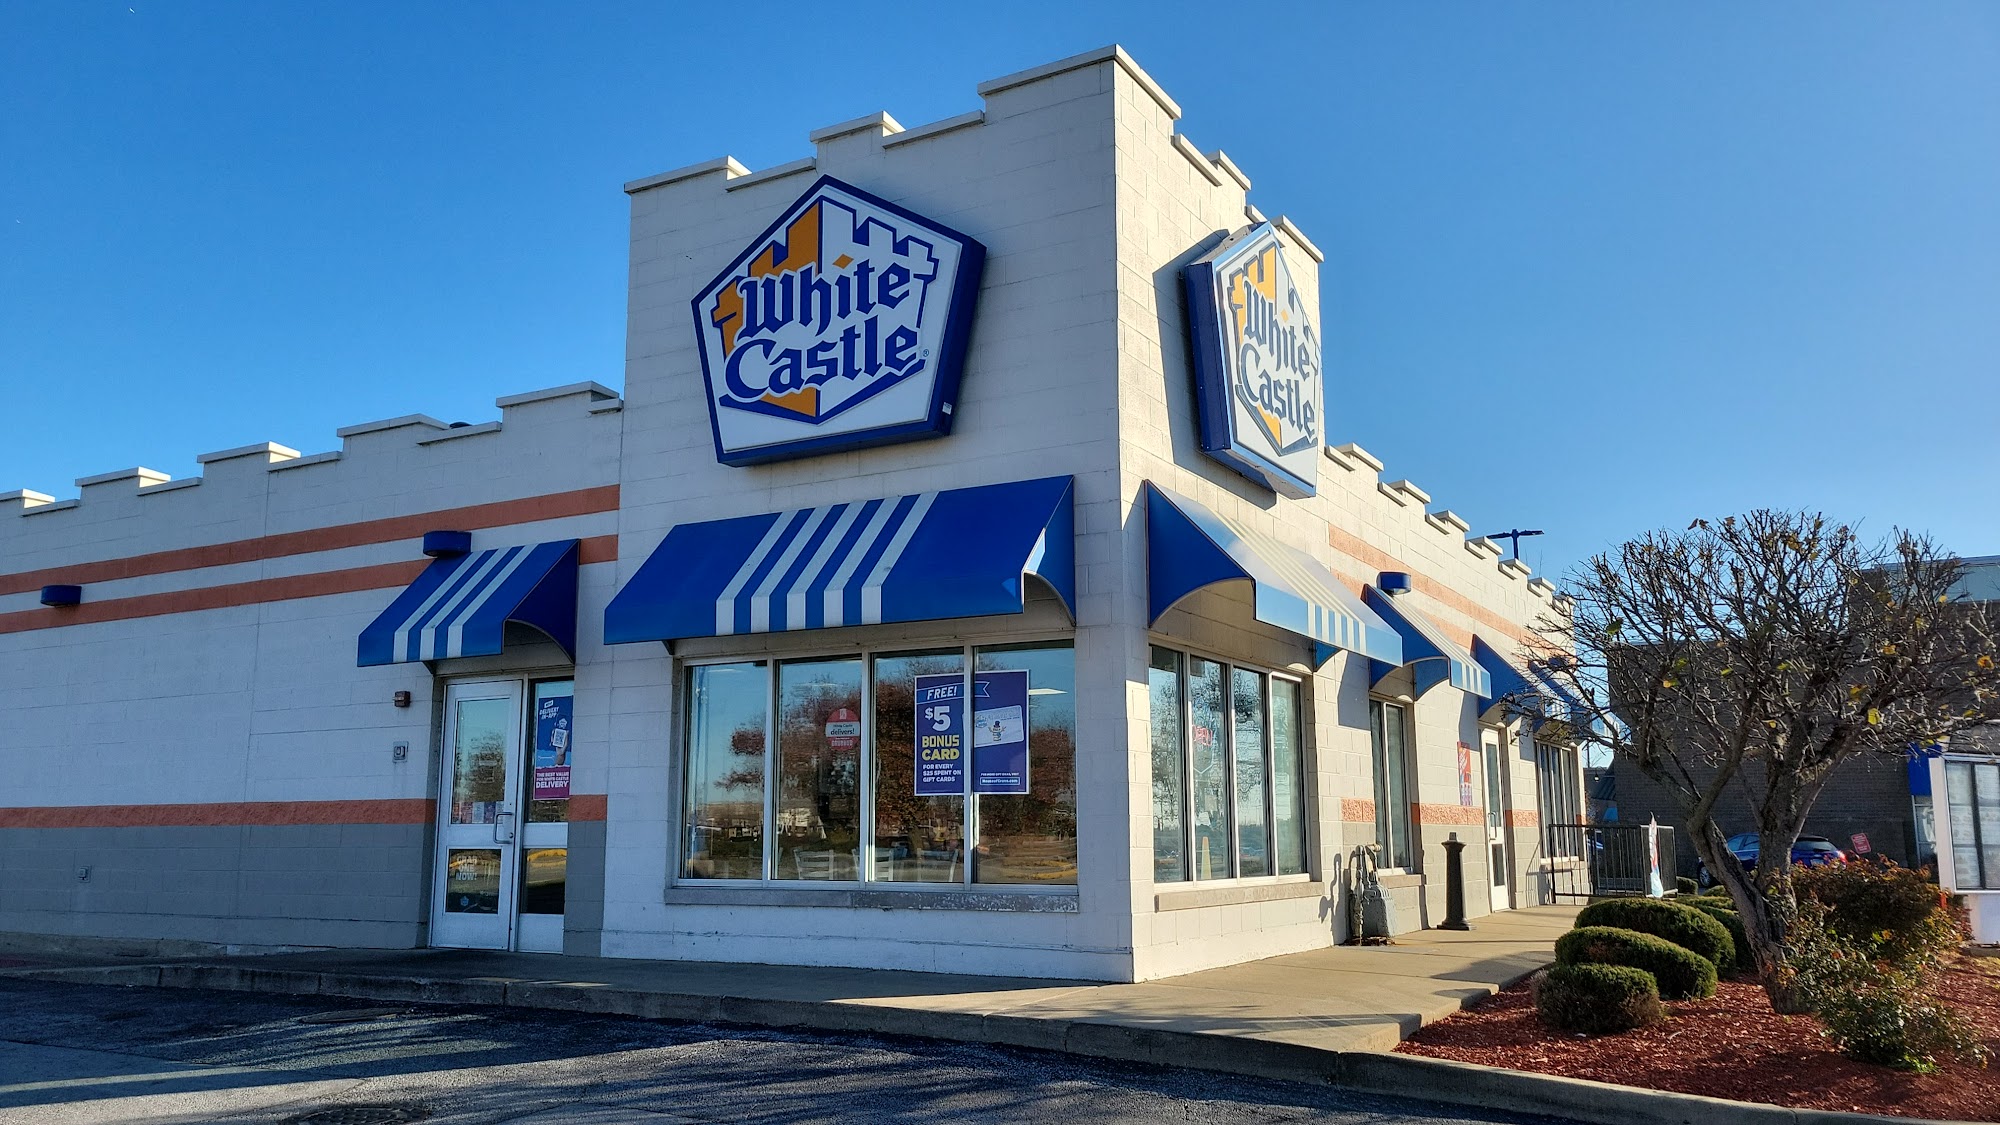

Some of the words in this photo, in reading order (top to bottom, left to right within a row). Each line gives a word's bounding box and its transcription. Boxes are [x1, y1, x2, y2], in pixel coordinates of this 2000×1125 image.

[737, 257, 911, 341] White
[1243, 283, 1310, 381] White
[725, 314, 918, 399] Castle
[1240, 343, 1315, 438] Castle
[927, 686, 957, 700] FREE!
[539, 707, 559, 715] DELIVERY
[924, 705, 951, 732] $5
[921, 734, 960, 748] BONUS
[921, 748, 960, 761] CARD
[455, 872, 478, 881] NOW!
